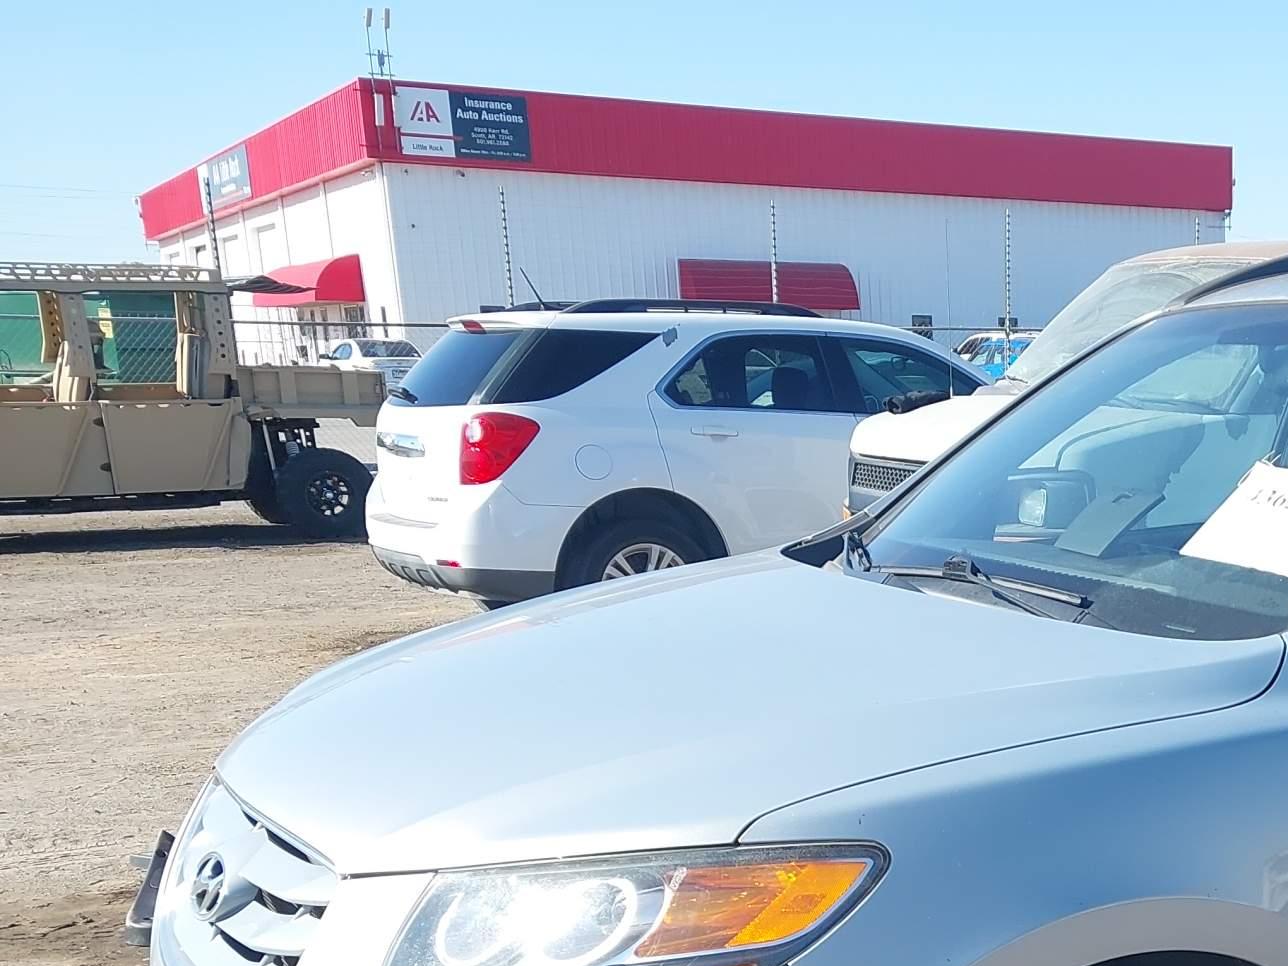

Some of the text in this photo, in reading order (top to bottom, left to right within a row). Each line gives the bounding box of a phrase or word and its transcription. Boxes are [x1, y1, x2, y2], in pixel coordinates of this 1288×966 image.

[464, 97, 512, 110] Insurance
[456, 109, 524, 123] Auto Auctions
[412, 143, 427, 151] Little
